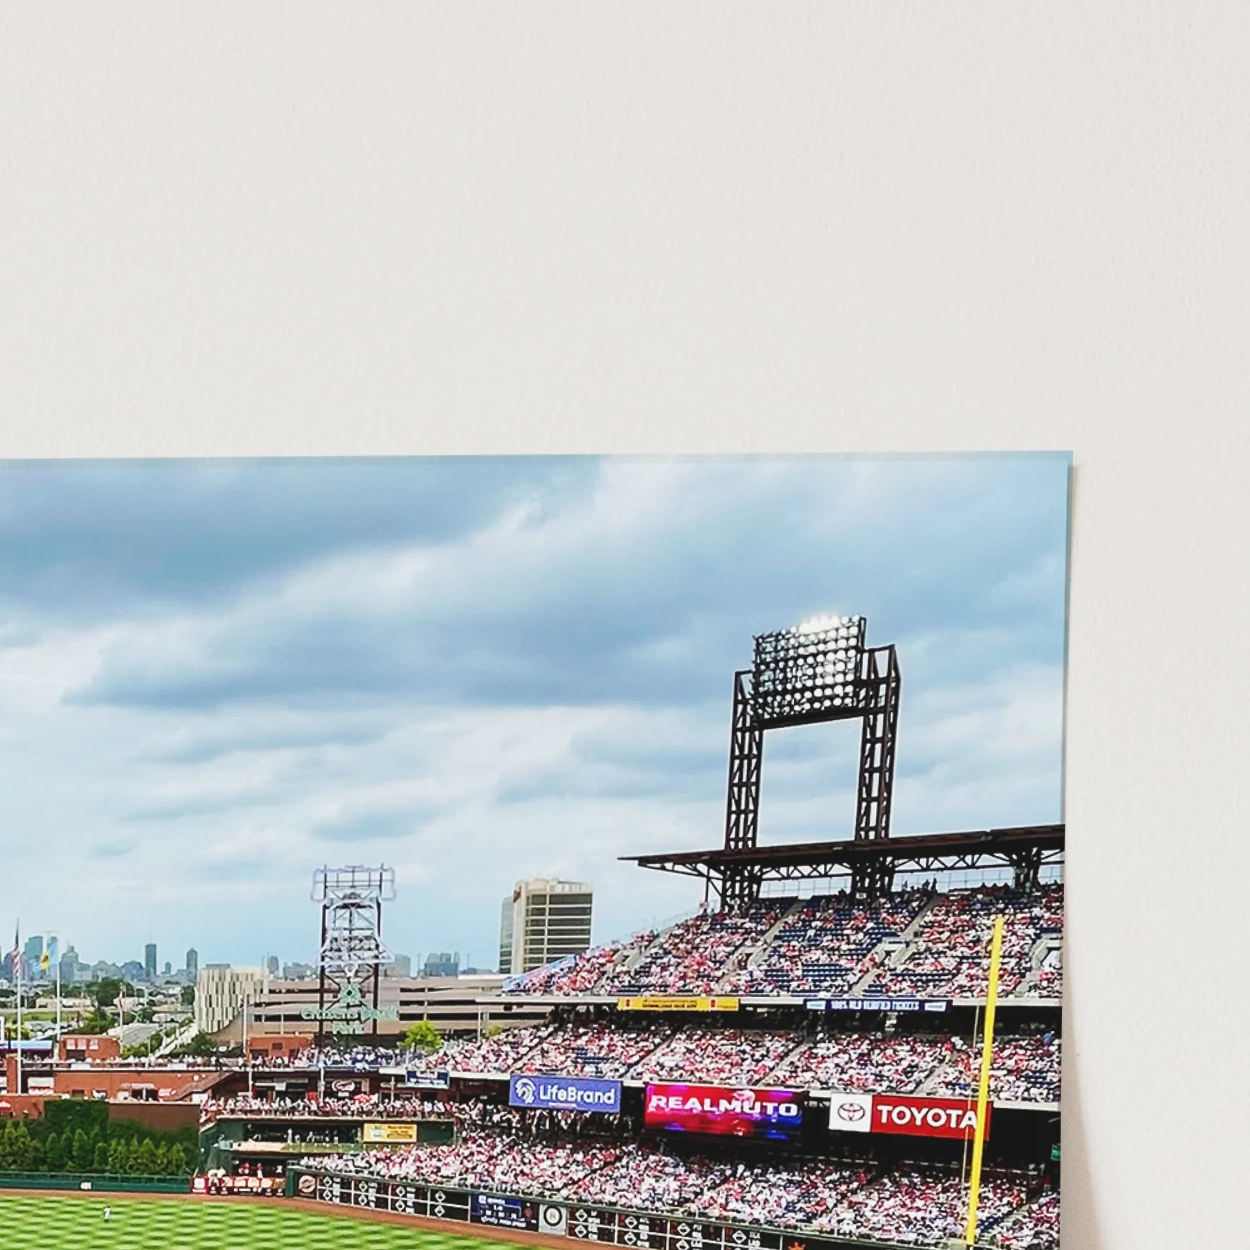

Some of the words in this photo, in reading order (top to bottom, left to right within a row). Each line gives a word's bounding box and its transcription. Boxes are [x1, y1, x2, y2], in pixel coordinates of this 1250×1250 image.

[539, 1085, 615, 1105] LifeBrand
[651, 1094, 798, 1117] REALMUTO
[877, 1105, 980, 1129] TOYOTA
